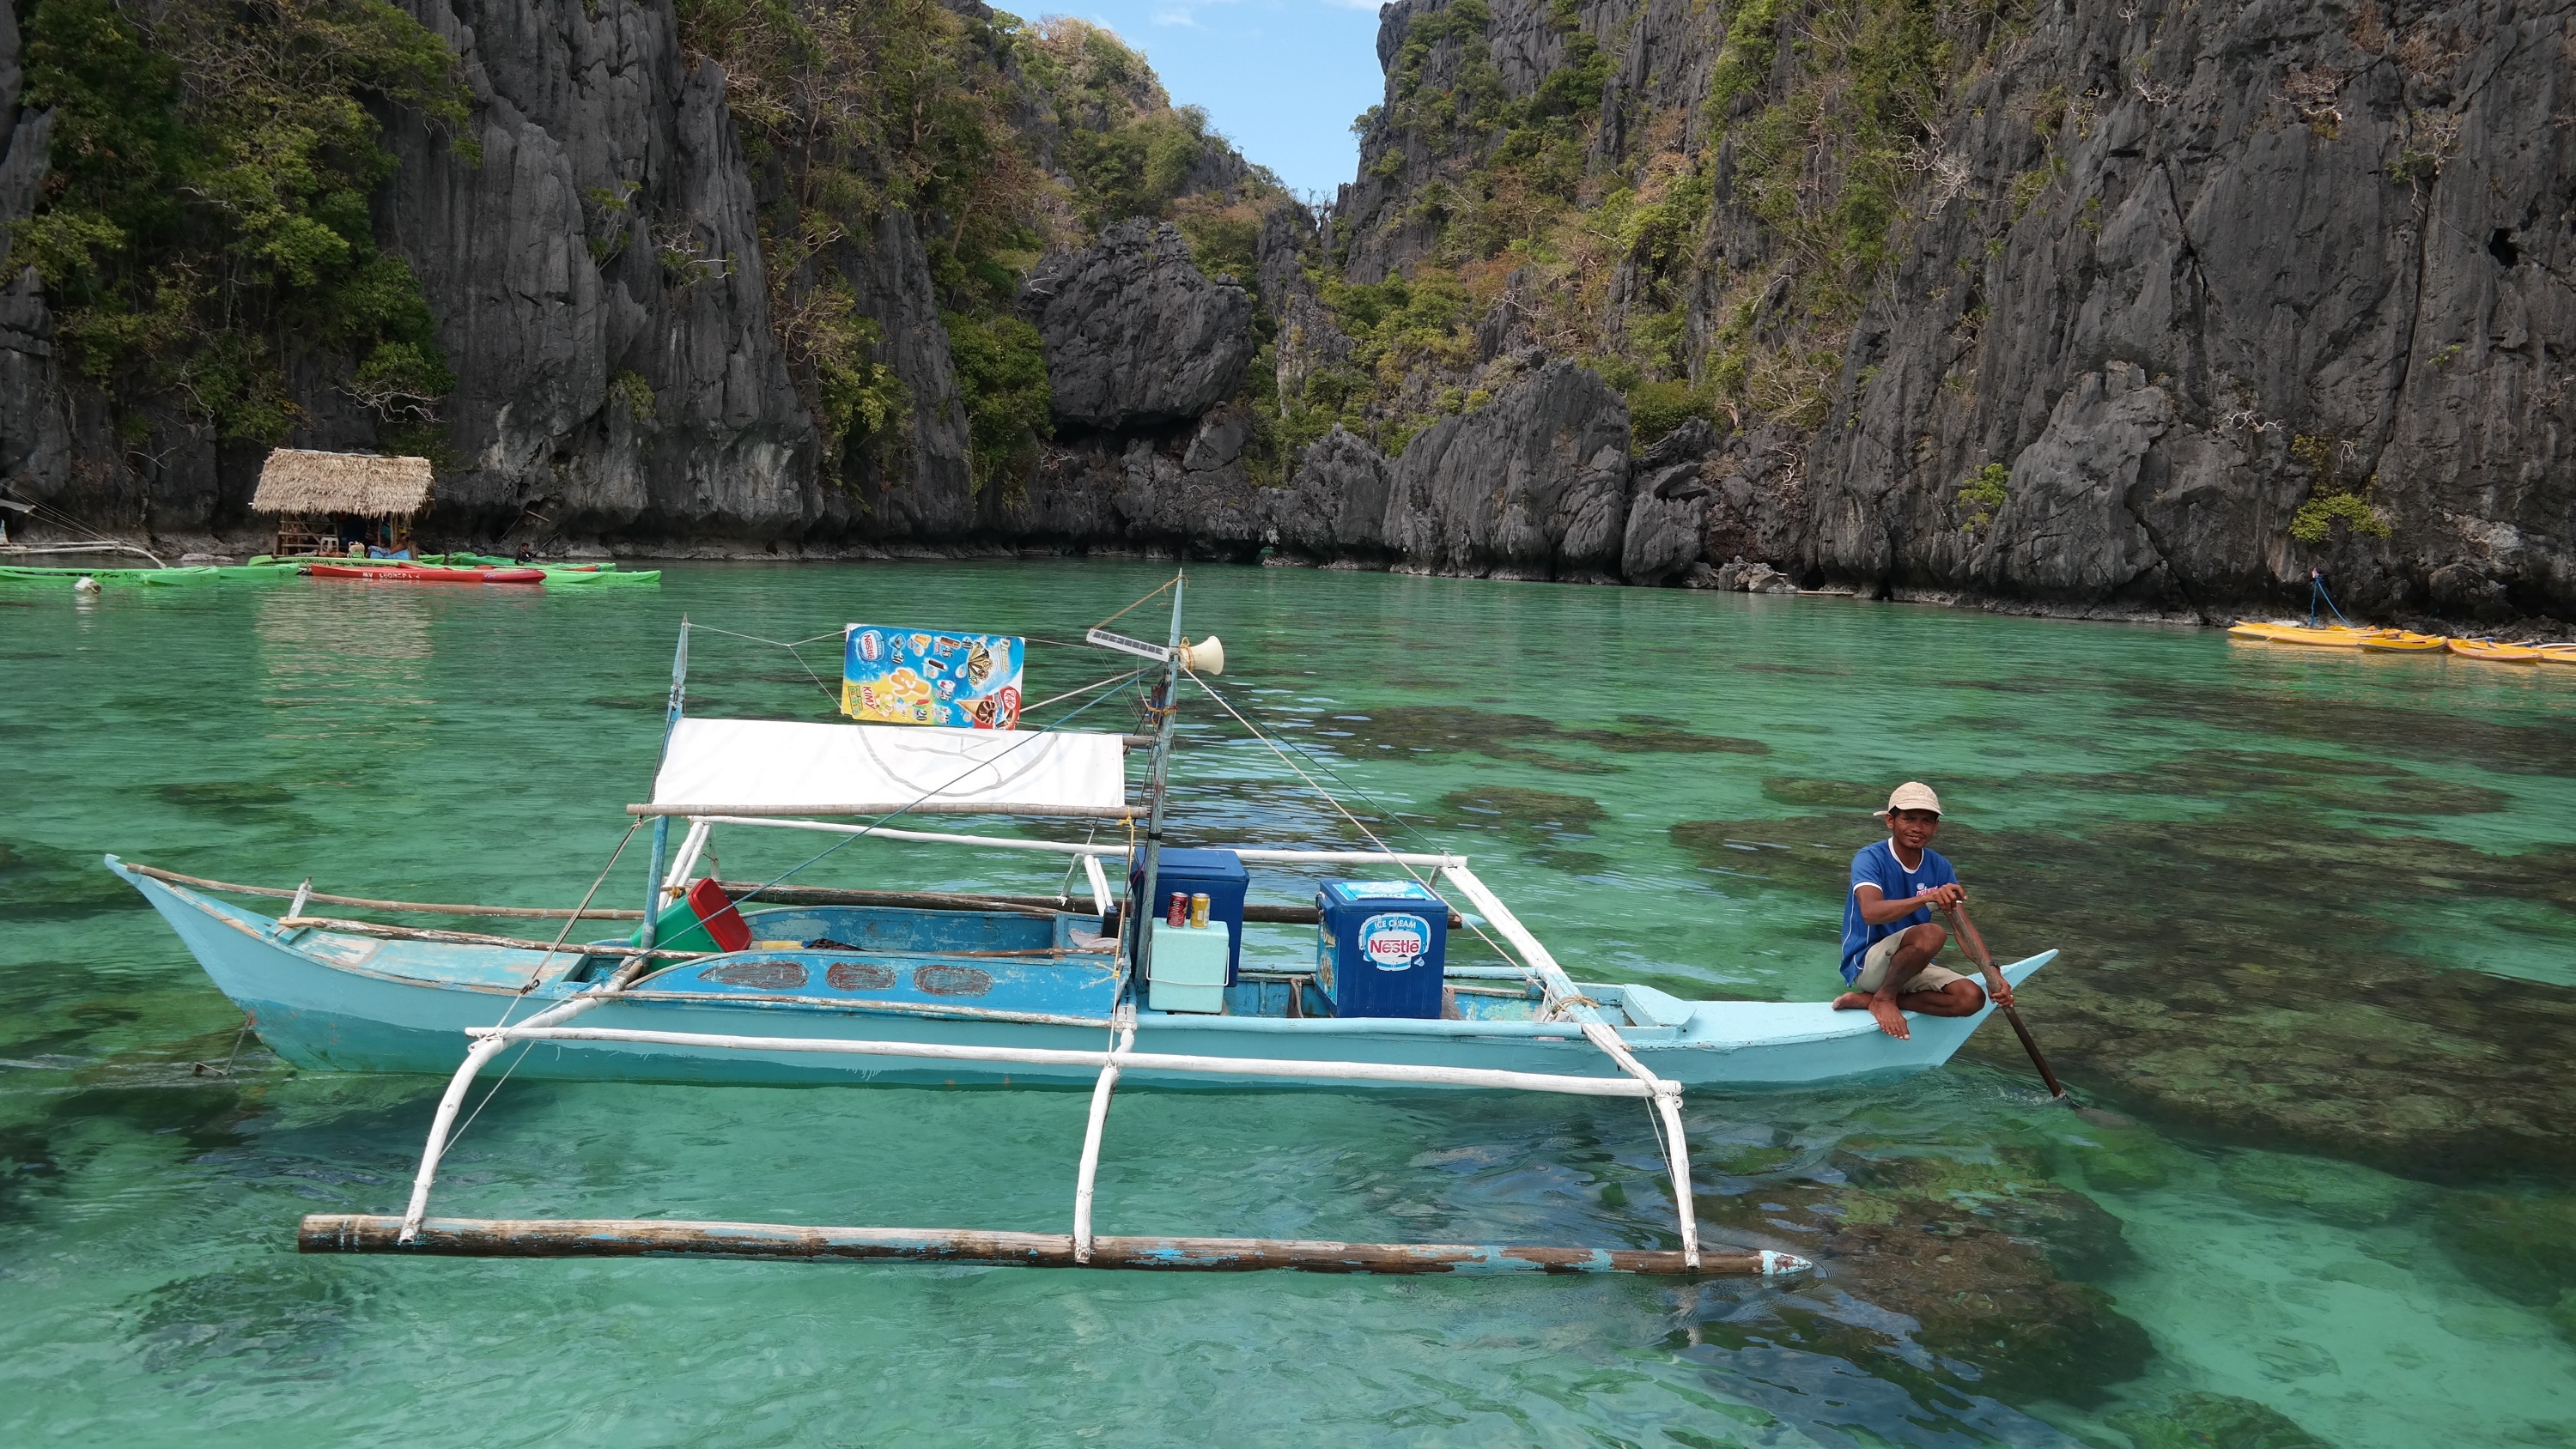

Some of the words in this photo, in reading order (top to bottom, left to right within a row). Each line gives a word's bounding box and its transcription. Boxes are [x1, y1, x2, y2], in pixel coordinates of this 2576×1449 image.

[962, 639, 973, 649] 40
[942, 647, 953, 658] 45
[892, 653, 904, 664] 30
[863, 686, 876, 710] KIMY
[939, 690, 952, 701] 25
[916, 710, 928, 721] 20
[1374, 920, 1387, 929] ICE
[1388, 919, 1417, 929] CREAM
